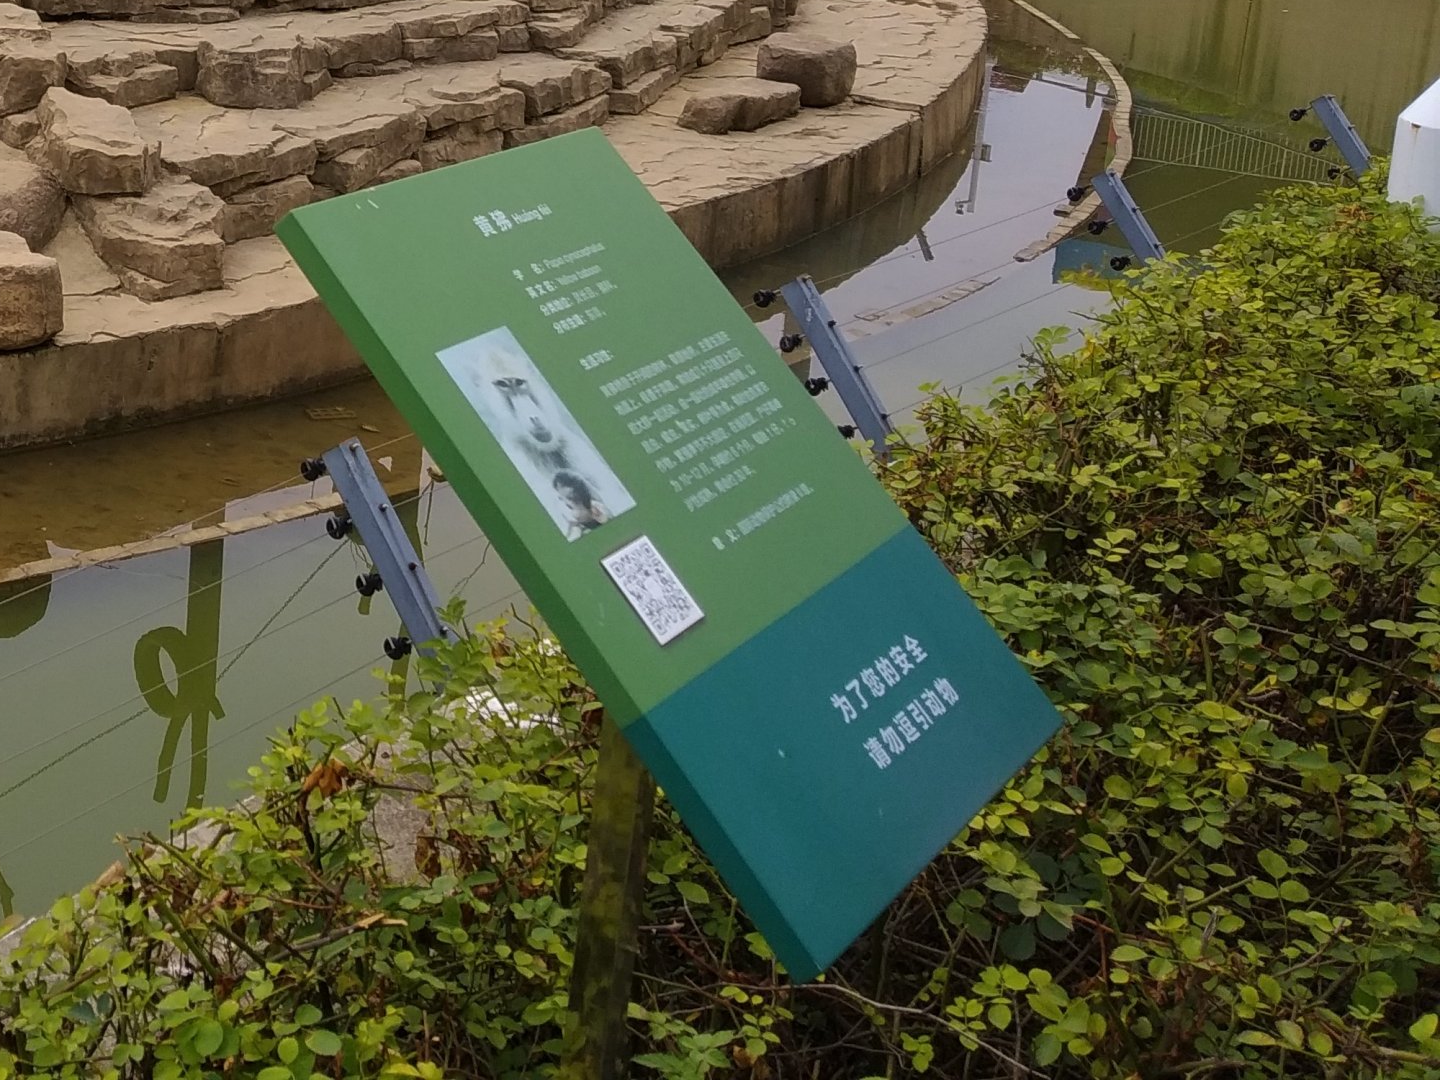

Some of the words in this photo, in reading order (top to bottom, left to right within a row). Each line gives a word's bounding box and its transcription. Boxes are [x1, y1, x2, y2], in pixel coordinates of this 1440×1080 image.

[830, 635, 928, 723] 为了您的安全
[863, 678, 959, 769] 请勿逗引动物
